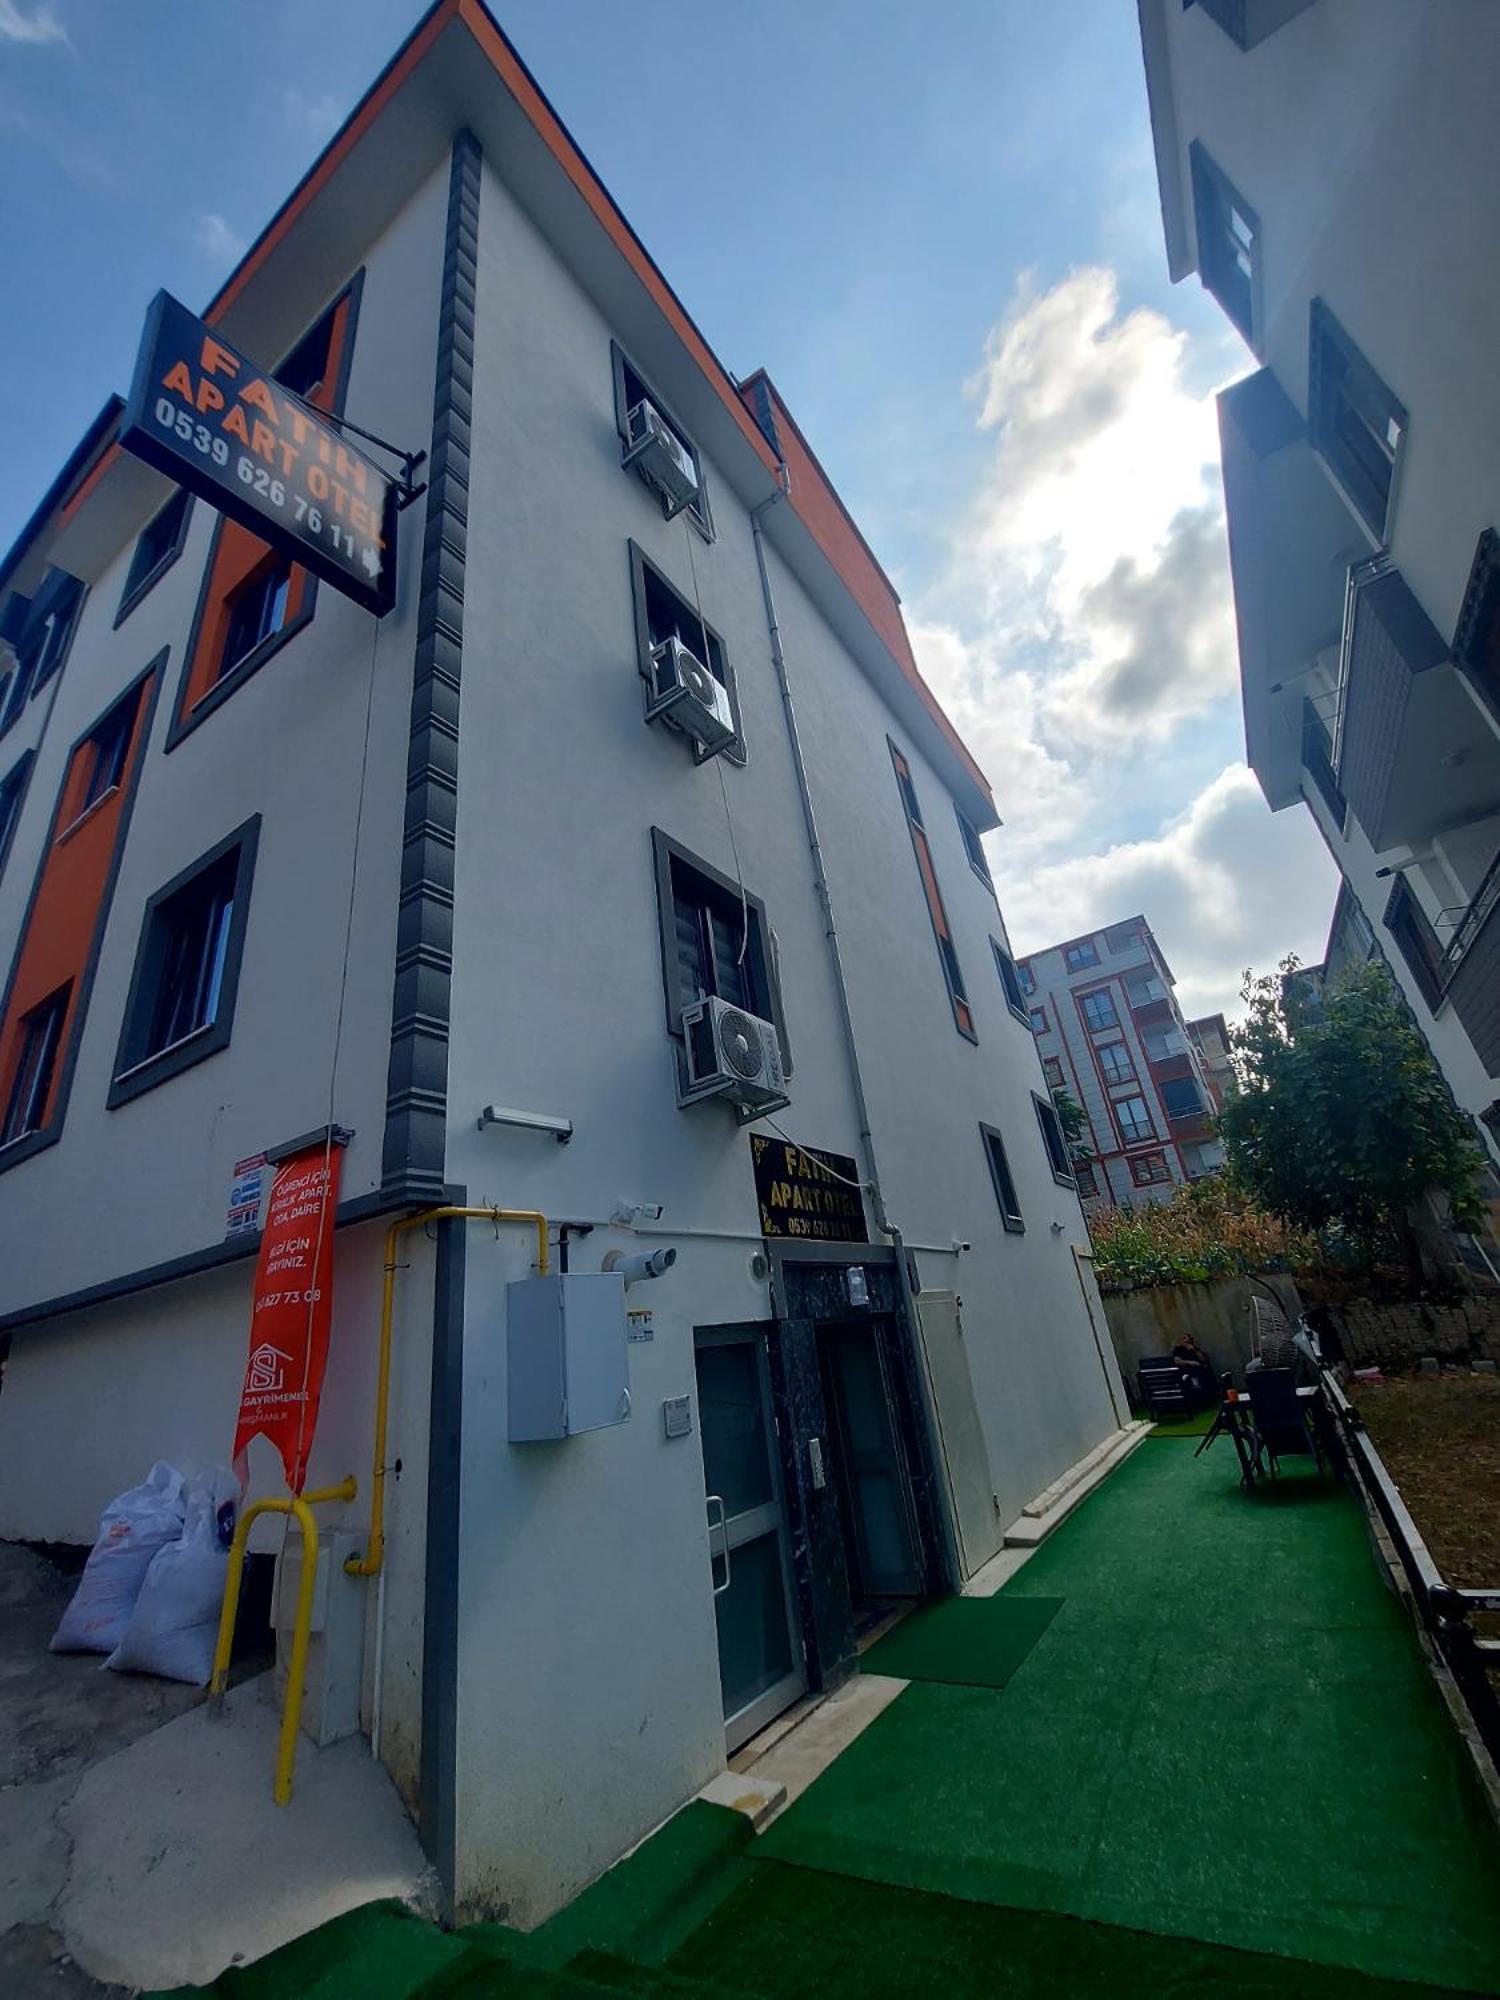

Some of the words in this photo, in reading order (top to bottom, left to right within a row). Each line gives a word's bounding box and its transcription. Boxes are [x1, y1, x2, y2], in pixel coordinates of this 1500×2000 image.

[155, 398, 229, 467] 0539
[237, 456, 285, 507] 626
[293, 495, 322, 534] 76
[330, 524, 353, 559] 11
[161, 360, 300, 477] APART
[307, 465, 385, 550] OTEL
[283, 1291, 300, 1304] 73
